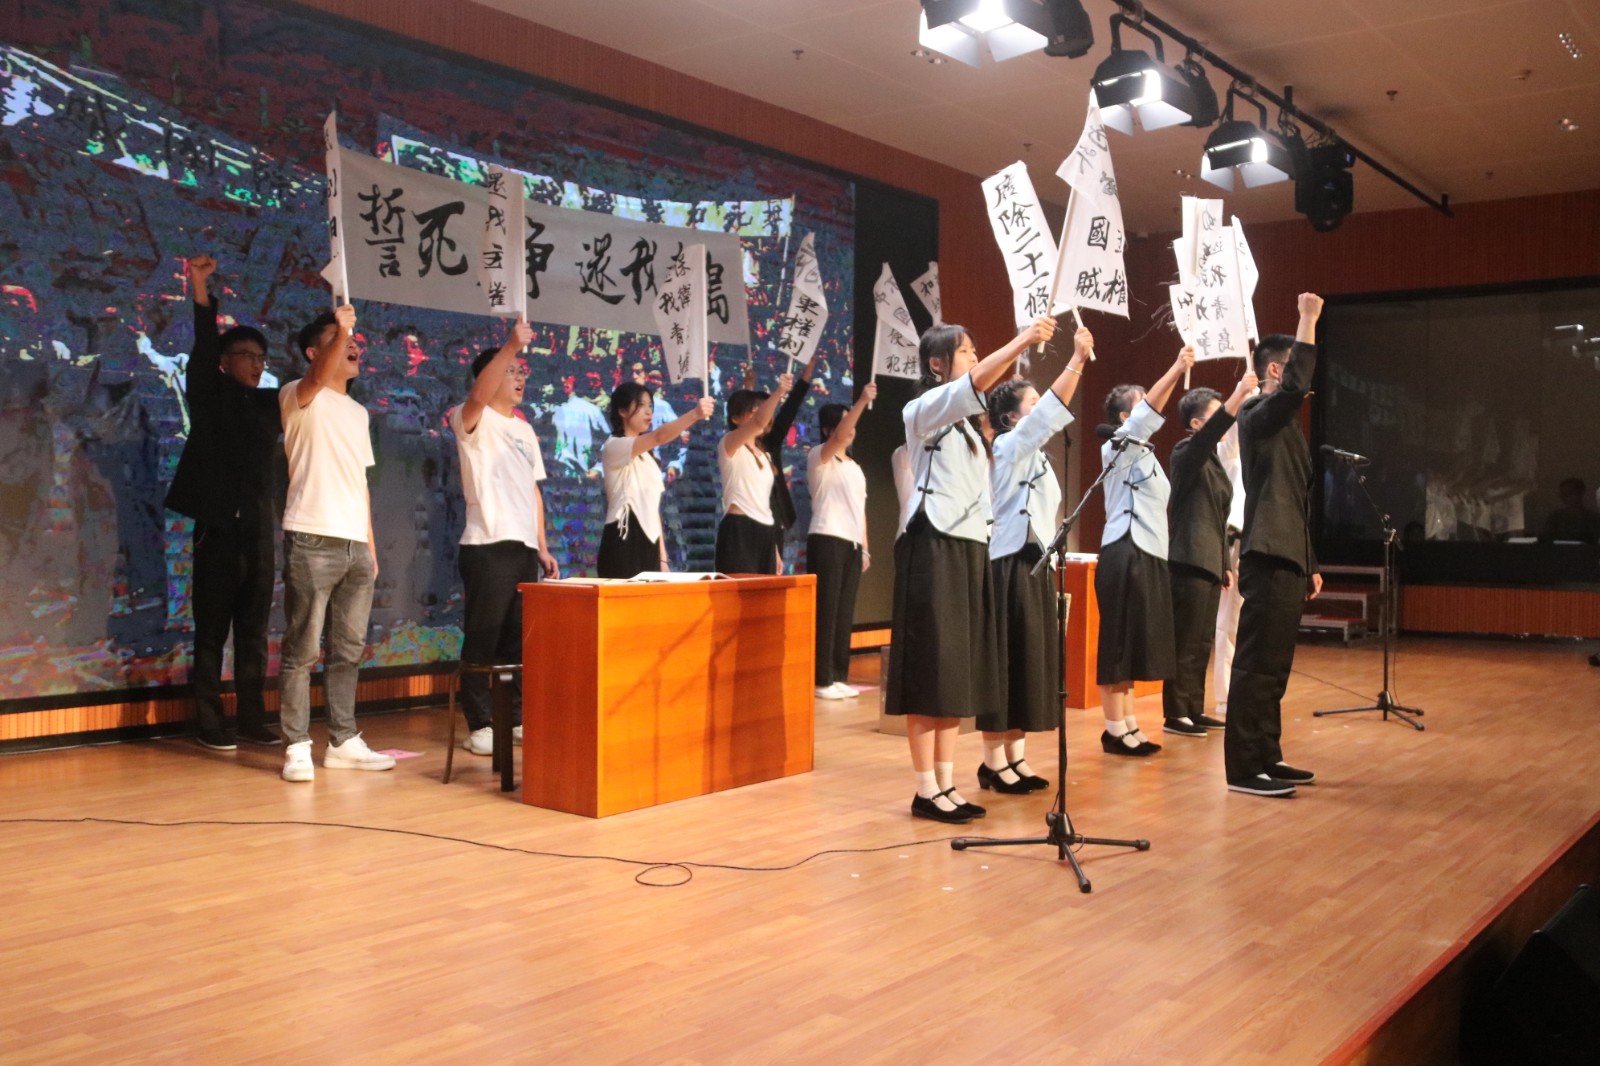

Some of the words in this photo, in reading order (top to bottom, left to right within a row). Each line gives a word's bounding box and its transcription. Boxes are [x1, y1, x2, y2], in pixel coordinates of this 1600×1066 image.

[993, 173, 1050, 318] 廢除二十一條
[1075, 215, 1110, 300] 國賊
